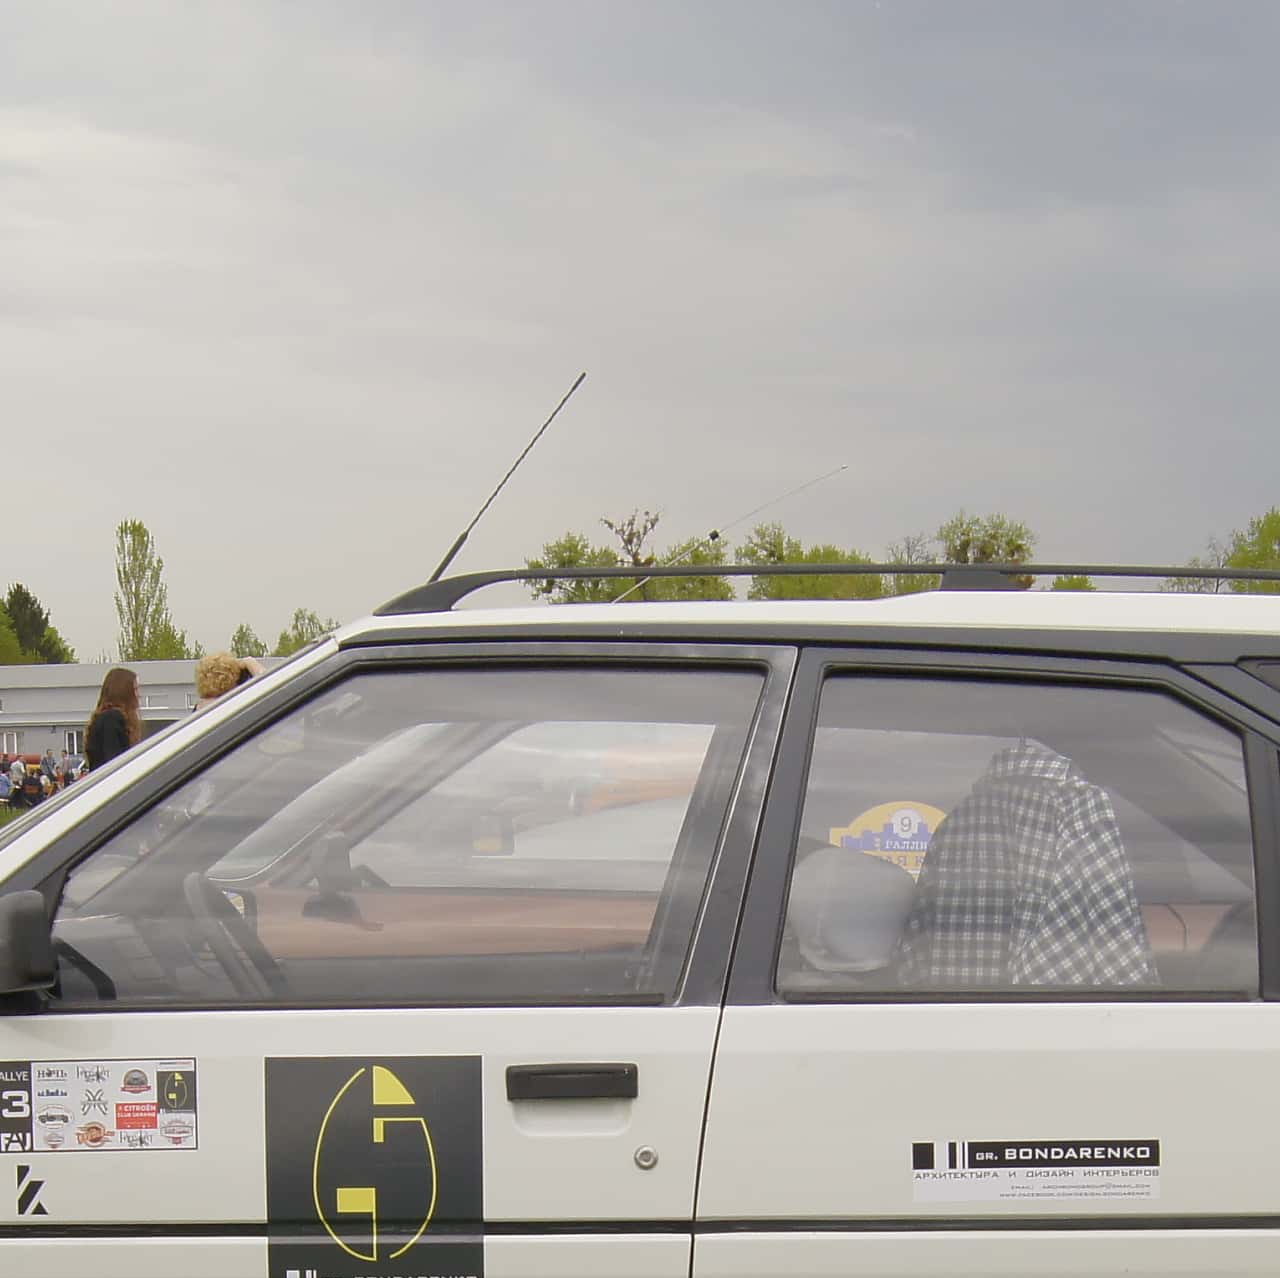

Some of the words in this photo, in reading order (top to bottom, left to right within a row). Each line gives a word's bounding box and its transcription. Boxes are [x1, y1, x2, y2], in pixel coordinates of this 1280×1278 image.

[900, 816, 912, 832] 9
[976, 1152, 999, 1161] GR.
[1005, 1147, 1151, 1160] BONDARENKO
[914, 1170, 999, 1180] АРХИТЕКТУРА
[1025, 1169, 1075, 1178] ДИЗАЙН
[1083, 1169, 1160, 1177] ИНТЕРЬЕРОВ
